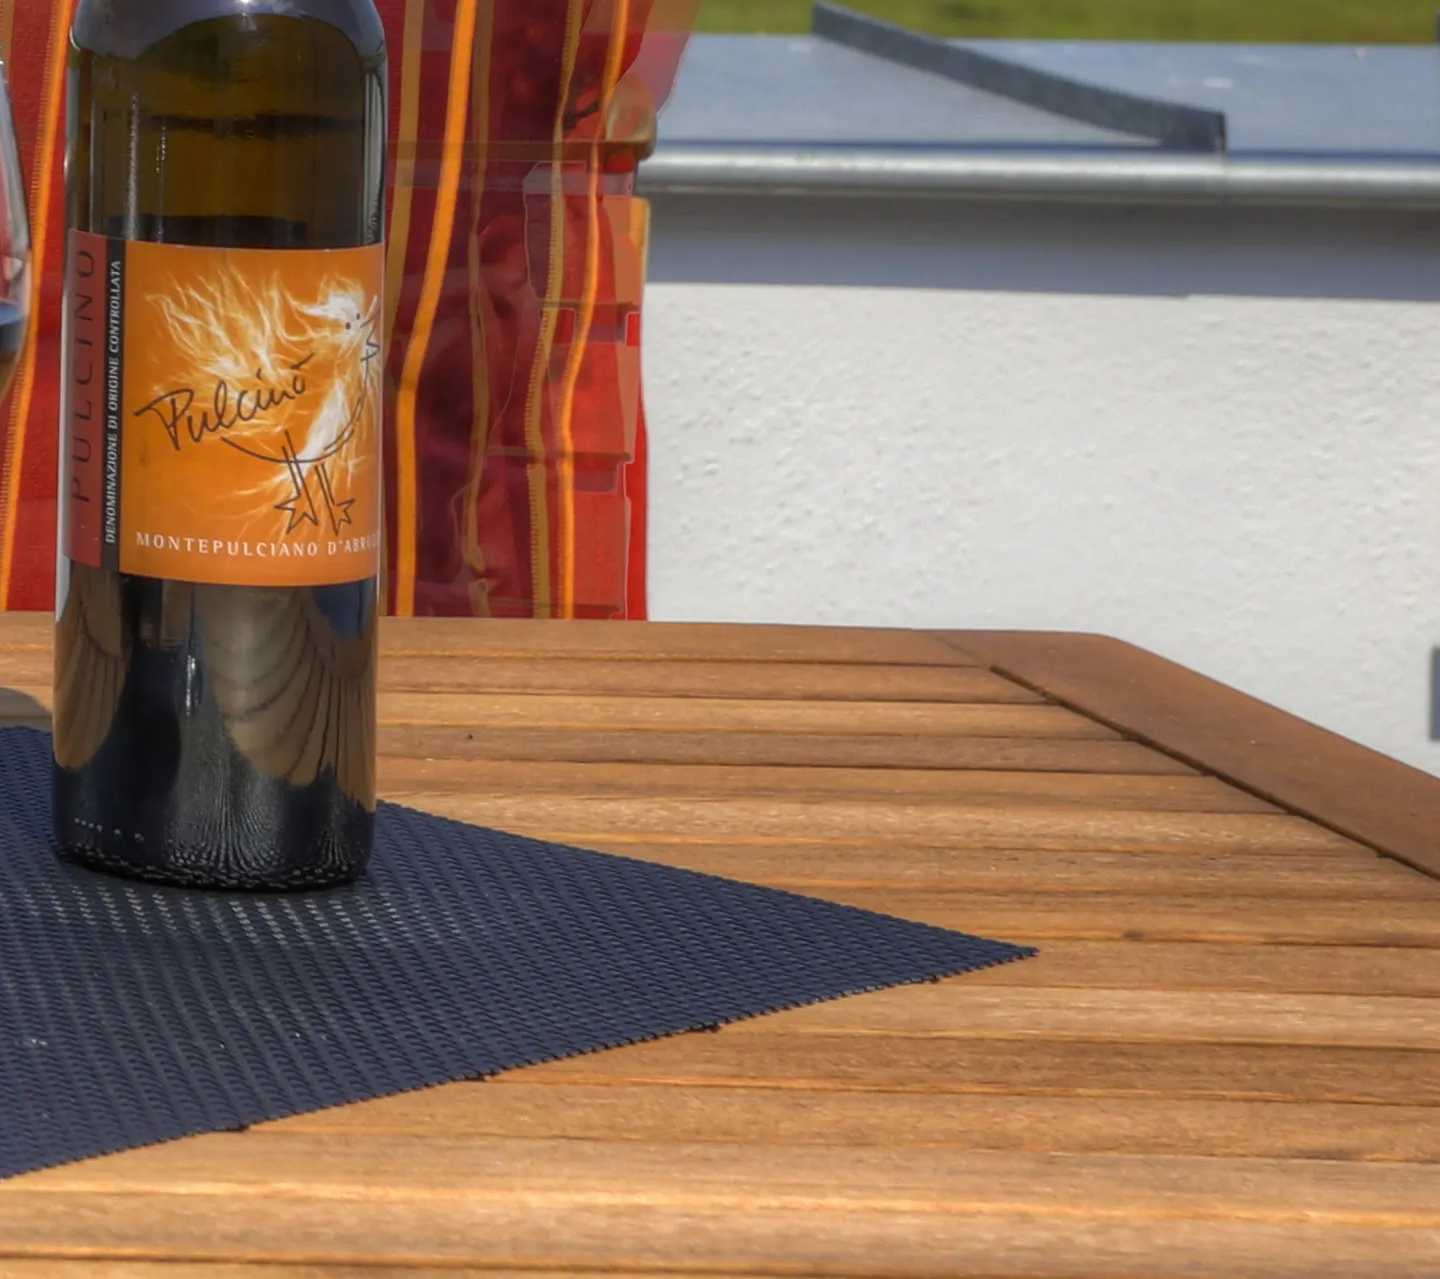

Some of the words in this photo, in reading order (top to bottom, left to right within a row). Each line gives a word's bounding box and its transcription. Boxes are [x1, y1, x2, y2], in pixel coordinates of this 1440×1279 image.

[108, 260, 122, 353] CONTROLLATA
[72, 249, 95, 503] PULCINO
[107, 357, 120, 411] ORIGINE
[107, 415, 118, 429] DI
[105, 433, 119, 544] DENOMINAZIONE
[136, 531, 318, 558] MONTEPULCIANO
